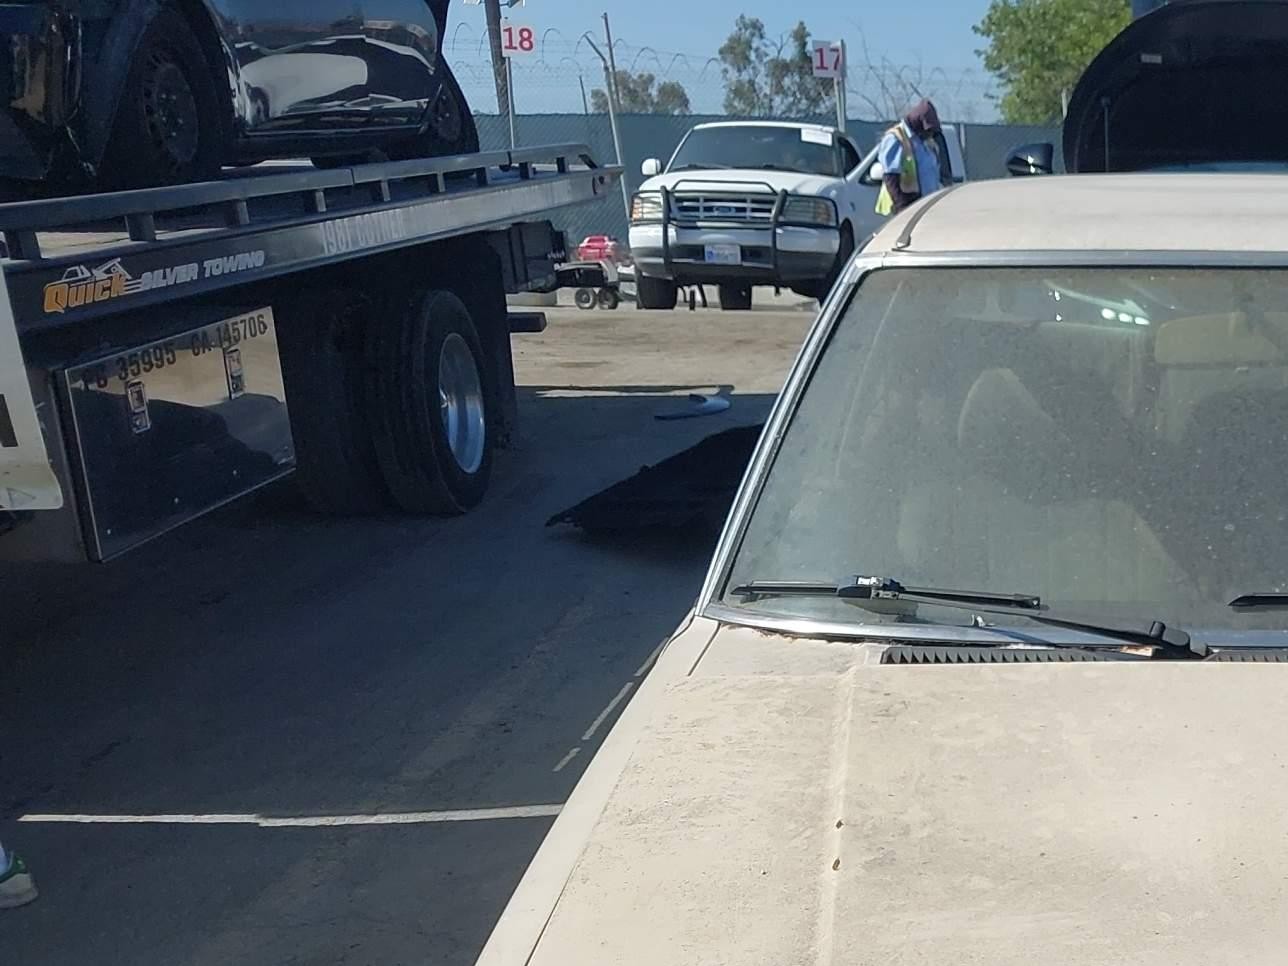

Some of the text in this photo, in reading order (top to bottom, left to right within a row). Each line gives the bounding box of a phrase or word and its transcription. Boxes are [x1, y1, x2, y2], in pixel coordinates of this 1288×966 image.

[503, 27, 534, 51] 18
[814, 48, 843, 71] 17
[142, 263, 199, 289] SILVER
[203, 251, 265, 276] TOWING
[116, 343, 177, 381] 35995
[216, 314, 268, 346] 145706
